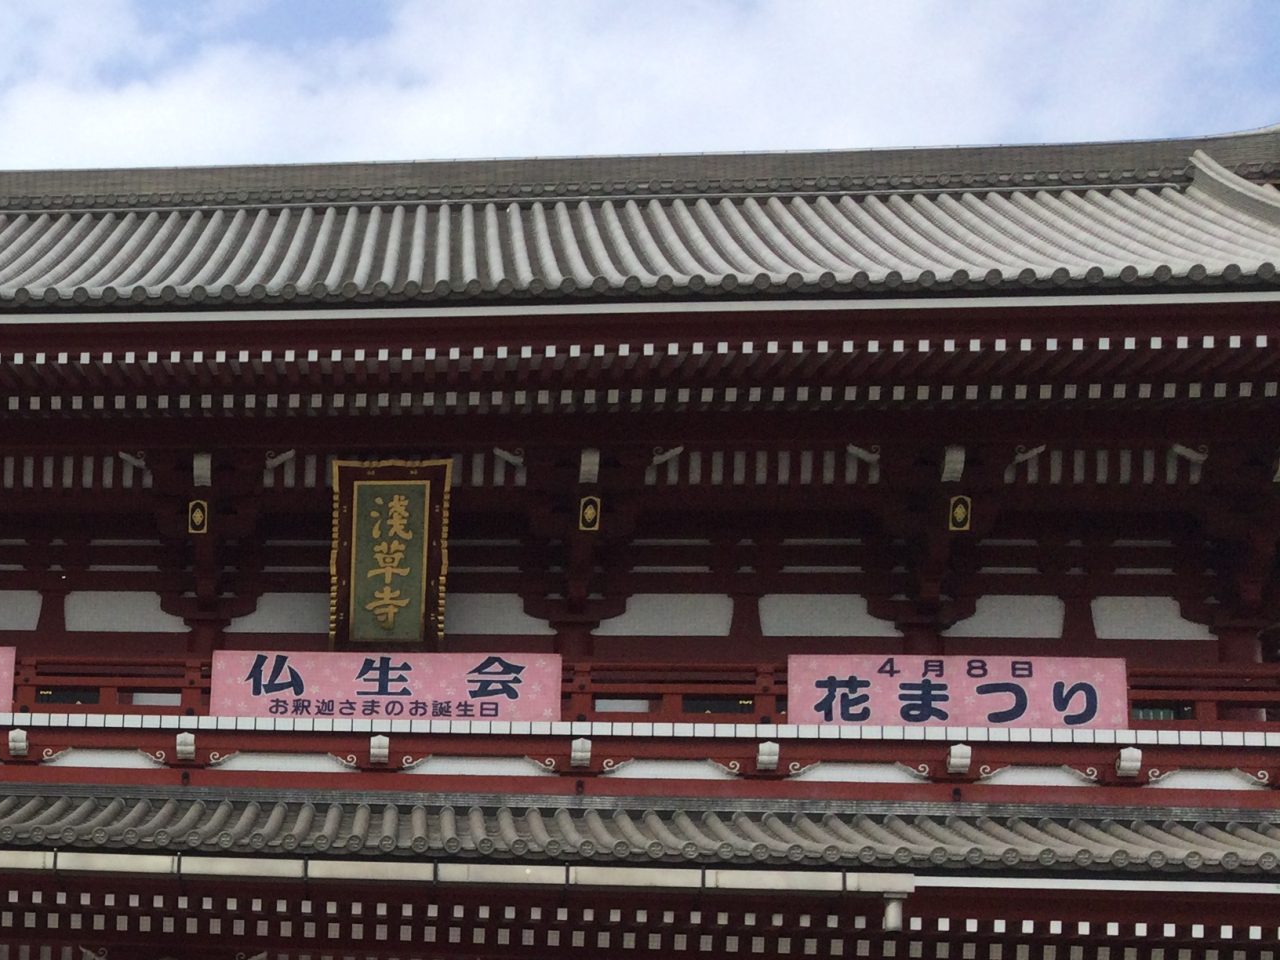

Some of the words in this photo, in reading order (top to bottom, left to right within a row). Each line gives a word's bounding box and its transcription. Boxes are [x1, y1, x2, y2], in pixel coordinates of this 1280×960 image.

[245, 654, 526, 699] 仏生会
[877, 657, 1034, 678] 4月8日
[268, 699, 500, 717] お釈迦さまのお誕生日
[814, 676, 1098, 725] 花まつり
